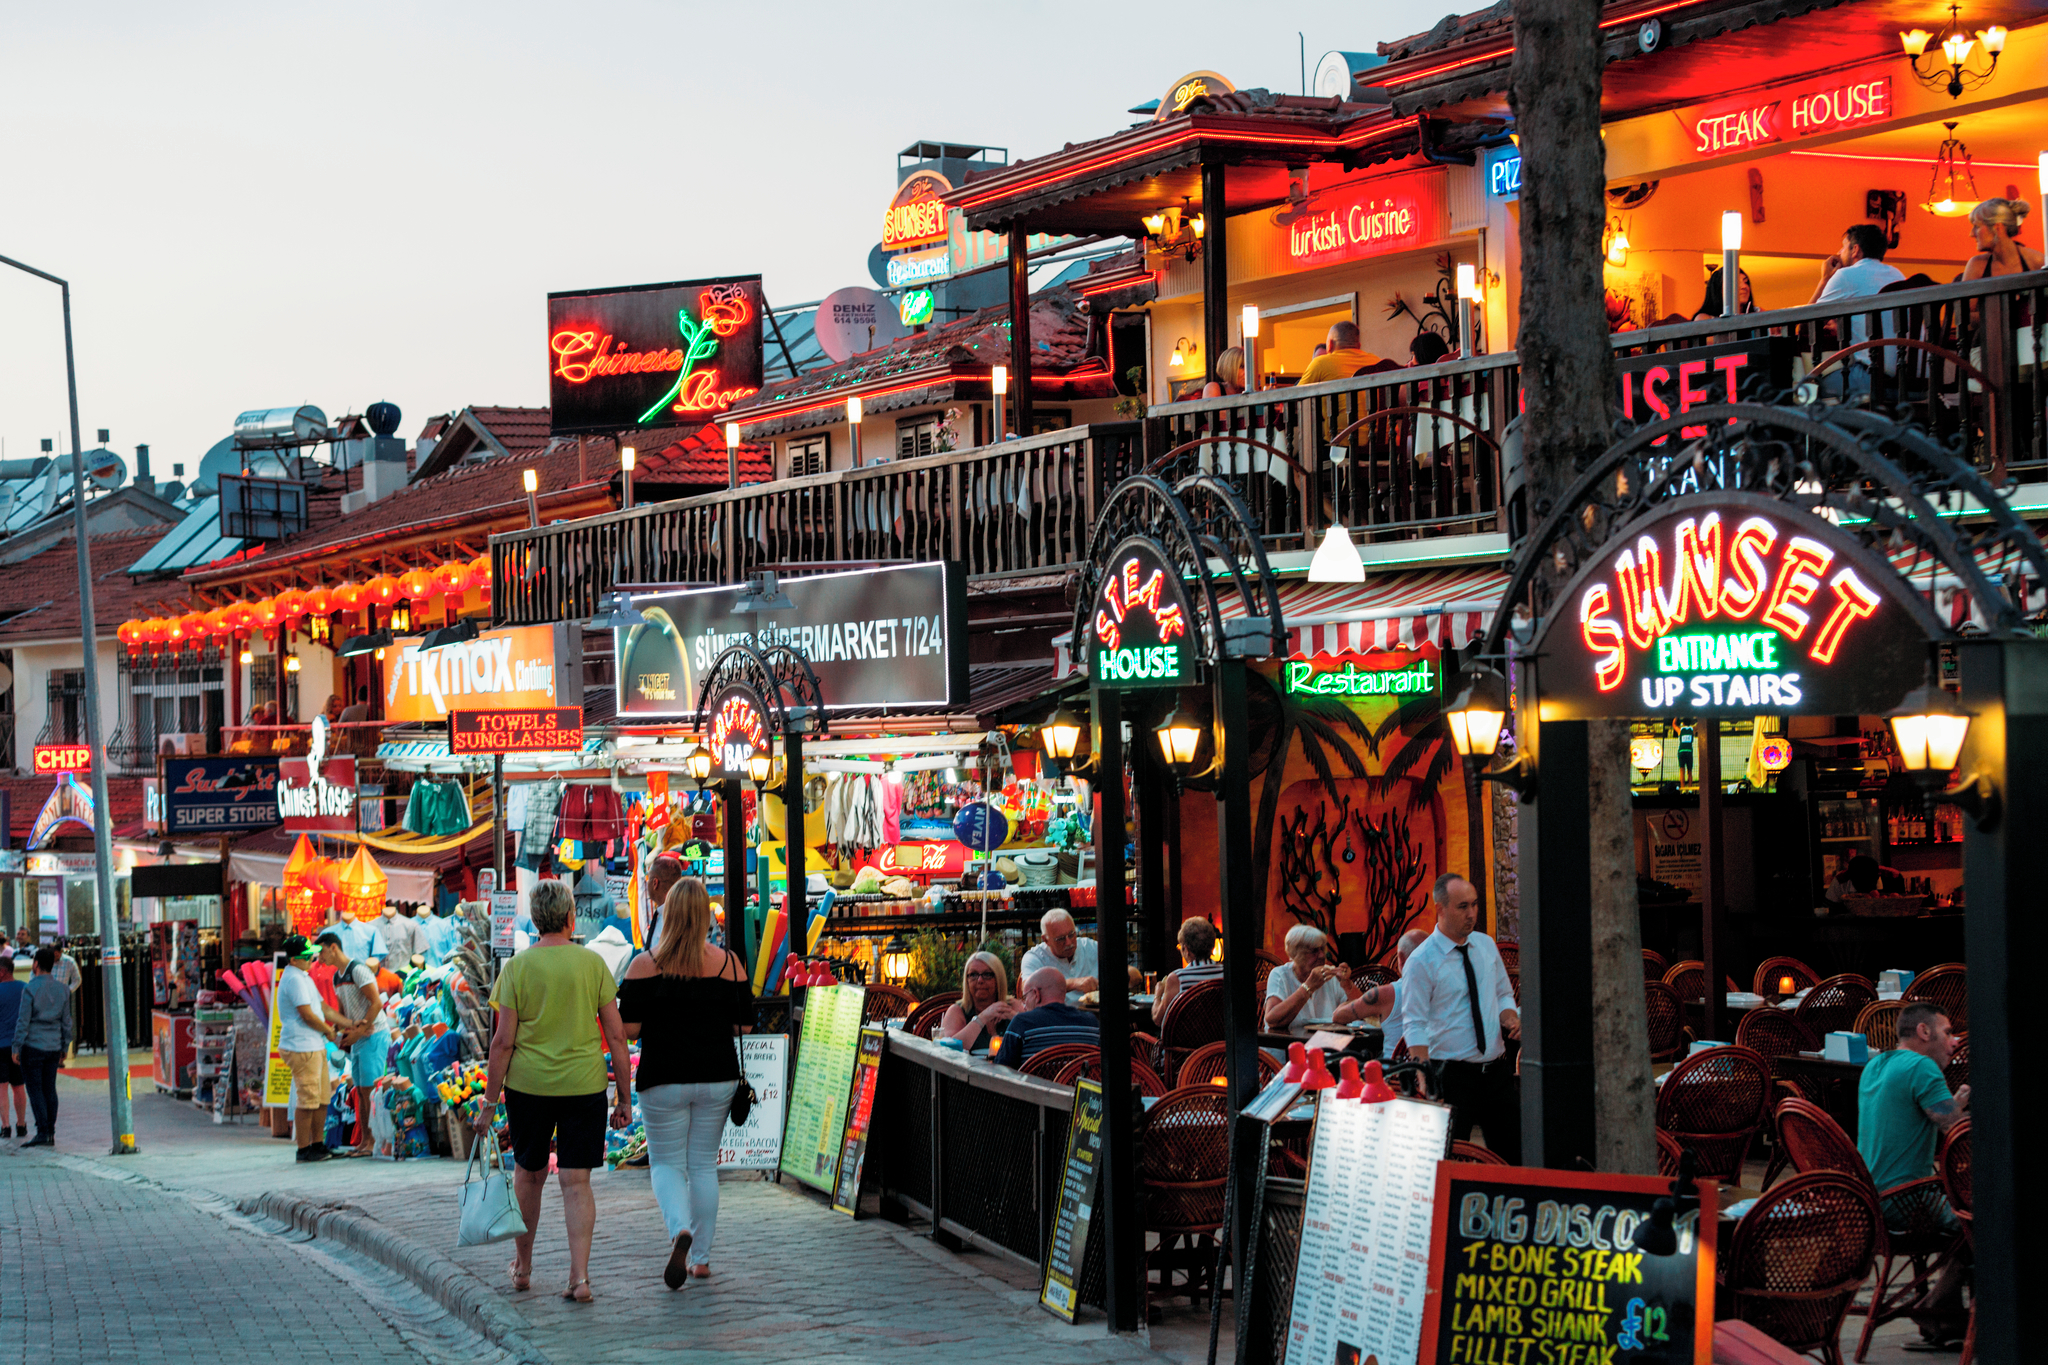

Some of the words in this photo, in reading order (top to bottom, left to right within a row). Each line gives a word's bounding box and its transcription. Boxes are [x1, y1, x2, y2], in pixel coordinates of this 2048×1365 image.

[1695, 105, 1770, 153] STEAK
[1791, 80, 1884, 129] HOUSE
[1491, 156, 1522, 194] PIZ
[884, 200, 947, 244] SUNSET
[1348, 198, 1411, 244] Cuisine
[887, 254, 949, 286] Restaurant
[902, 290, 930, 326] Bar
[552, 331, 685, 382] Chinese
[1096, 557, 1184, 652] STEAK
[1580, 511, 1882, 692] SUNSET
[902, 614, 943, 658] 7/24
[1657, 631, 1780, 673] ENTRANCE
[515, 657, 554, 698] Clothing
[1100, 645, 1180, 681] HOUSE
[1286, 659, 1435, 695] Restaurant
[1641, 686, 1685, 708] UP
[1690, 673, 1803, 707] STAIRS
[454, 729, 581, 749] SUNGLASSES
[476, 713, 558, 732] TOWELS
[36, 749, 90, 769] CHIP
[176, 809, 225, 825] SUPER
[229, 806, 276, 823] STORE
[318, 777, 350, 818] Rose
[970, 806, 987, 846] NIVEA
[879, 844, 951, 871] Coola
[716, 1148, 736, 1166] £12
[750, 1137, 779, 1149] BACON
[1459, 1192, 1528, 1244] BIG
[1532, 1199, 1702, 1256] DISCOT
[1462, 1240, 1558, 1278] T-BONE
[1561, 1246, 1644, 1285] STEAK
[1455, 1272, 1538, 1306] MIXED
[1540, 1278, 1613, 1313] GRILL
[1451, 1302, 1524, 1337] LAMB
[1530, 1306, 1611, 1346] SHANK
[1616, 1296, 1671, 1351] £12
[1449, 1334, 1537, 1365] FILLET
[1539, 1338, 1619, 1365] STEAK
